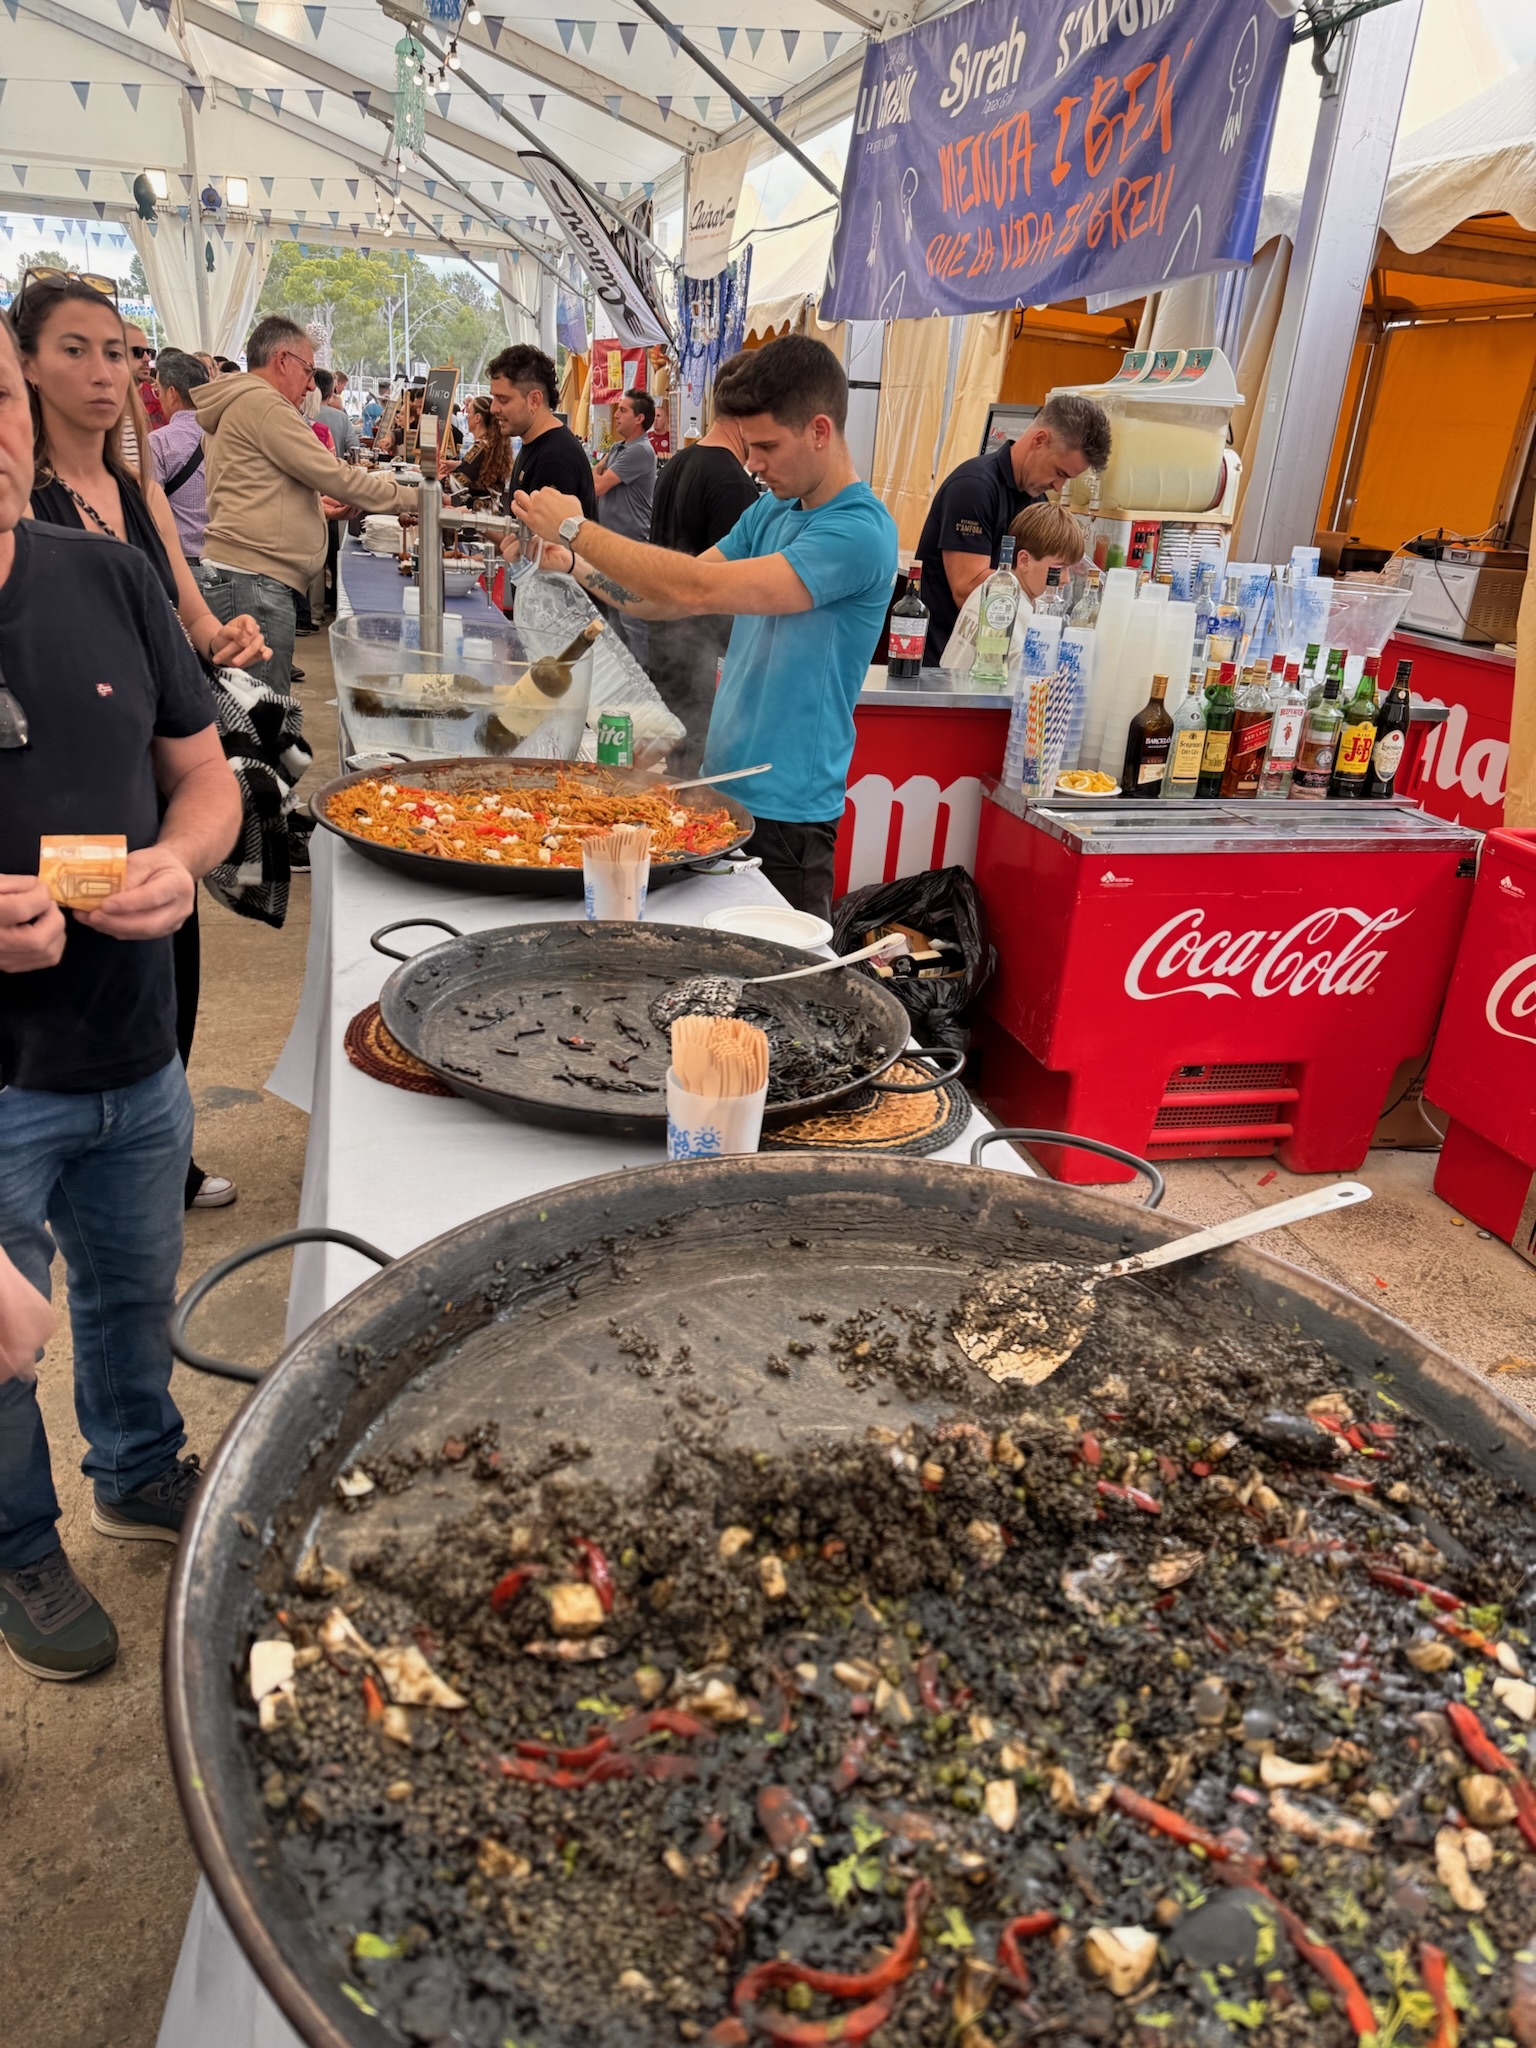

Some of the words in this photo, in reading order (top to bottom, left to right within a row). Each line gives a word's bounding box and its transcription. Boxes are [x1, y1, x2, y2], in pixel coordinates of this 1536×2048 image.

[939, 15, 1027, 119] Syrah
[938, 110, 1038, 220] MENJA
[1050, 96, 1083, 187] I
[925, 232, 972, 282] QUE
[967, 226, 996, 279] LA
[1000, 212, 1055, 273] VIDA
[428, 380, 450, 399] TINTO
[1280, 708, 1304, 716] BEEFEATER
[599, 723, 627, 747] ite
[1145, 735, 1172, 745] BARCELÓ
[1243, 733, 1255, 742] RED
[1344, 736, 1373, 763] J&B
[1124, 907, 1417, 1000] Coca-Cola
